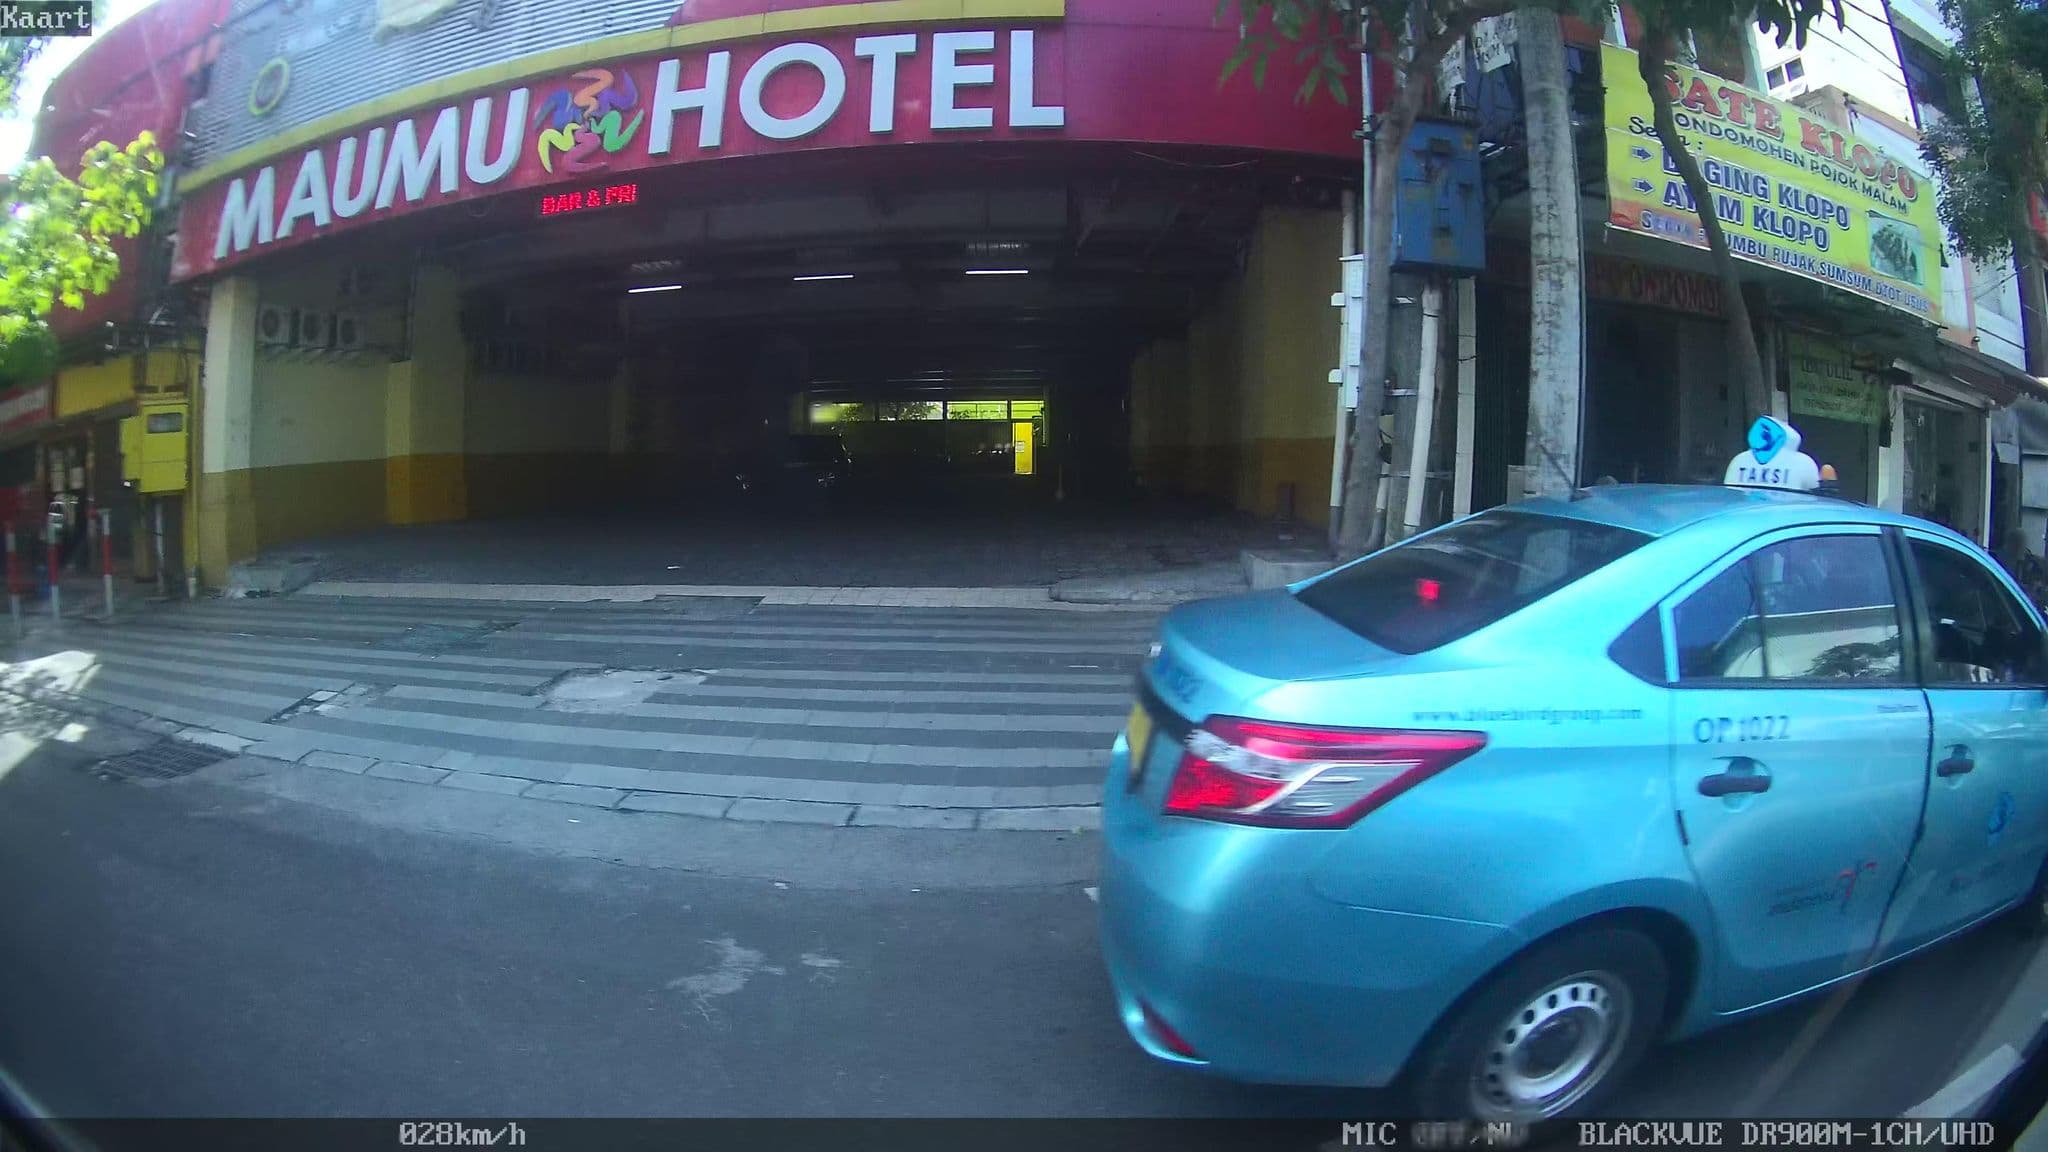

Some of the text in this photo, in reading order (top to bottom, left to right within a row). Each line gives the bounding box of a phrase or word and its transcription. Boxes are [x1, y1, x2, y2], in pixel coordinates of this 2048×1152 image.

[213, 30, 1065, 260] MAUMU HOTEL
[1674, 112, 1804, 167] ONDOMOHEN
[1861, 182, 1908, 215] MALAM
[1799, 117, 1917, 201] KLOPO
[542, 191, 582, 215] BAR
[586, 189, 601, 208] &
[1661, 145, 1850, 231] DGING KLOPO
[1662, 180, 1829, 252] AYM KLOPO
[1739, 467, 1790, 484] TAKSI
[1694, 714, 1791, 743] OP 1022
